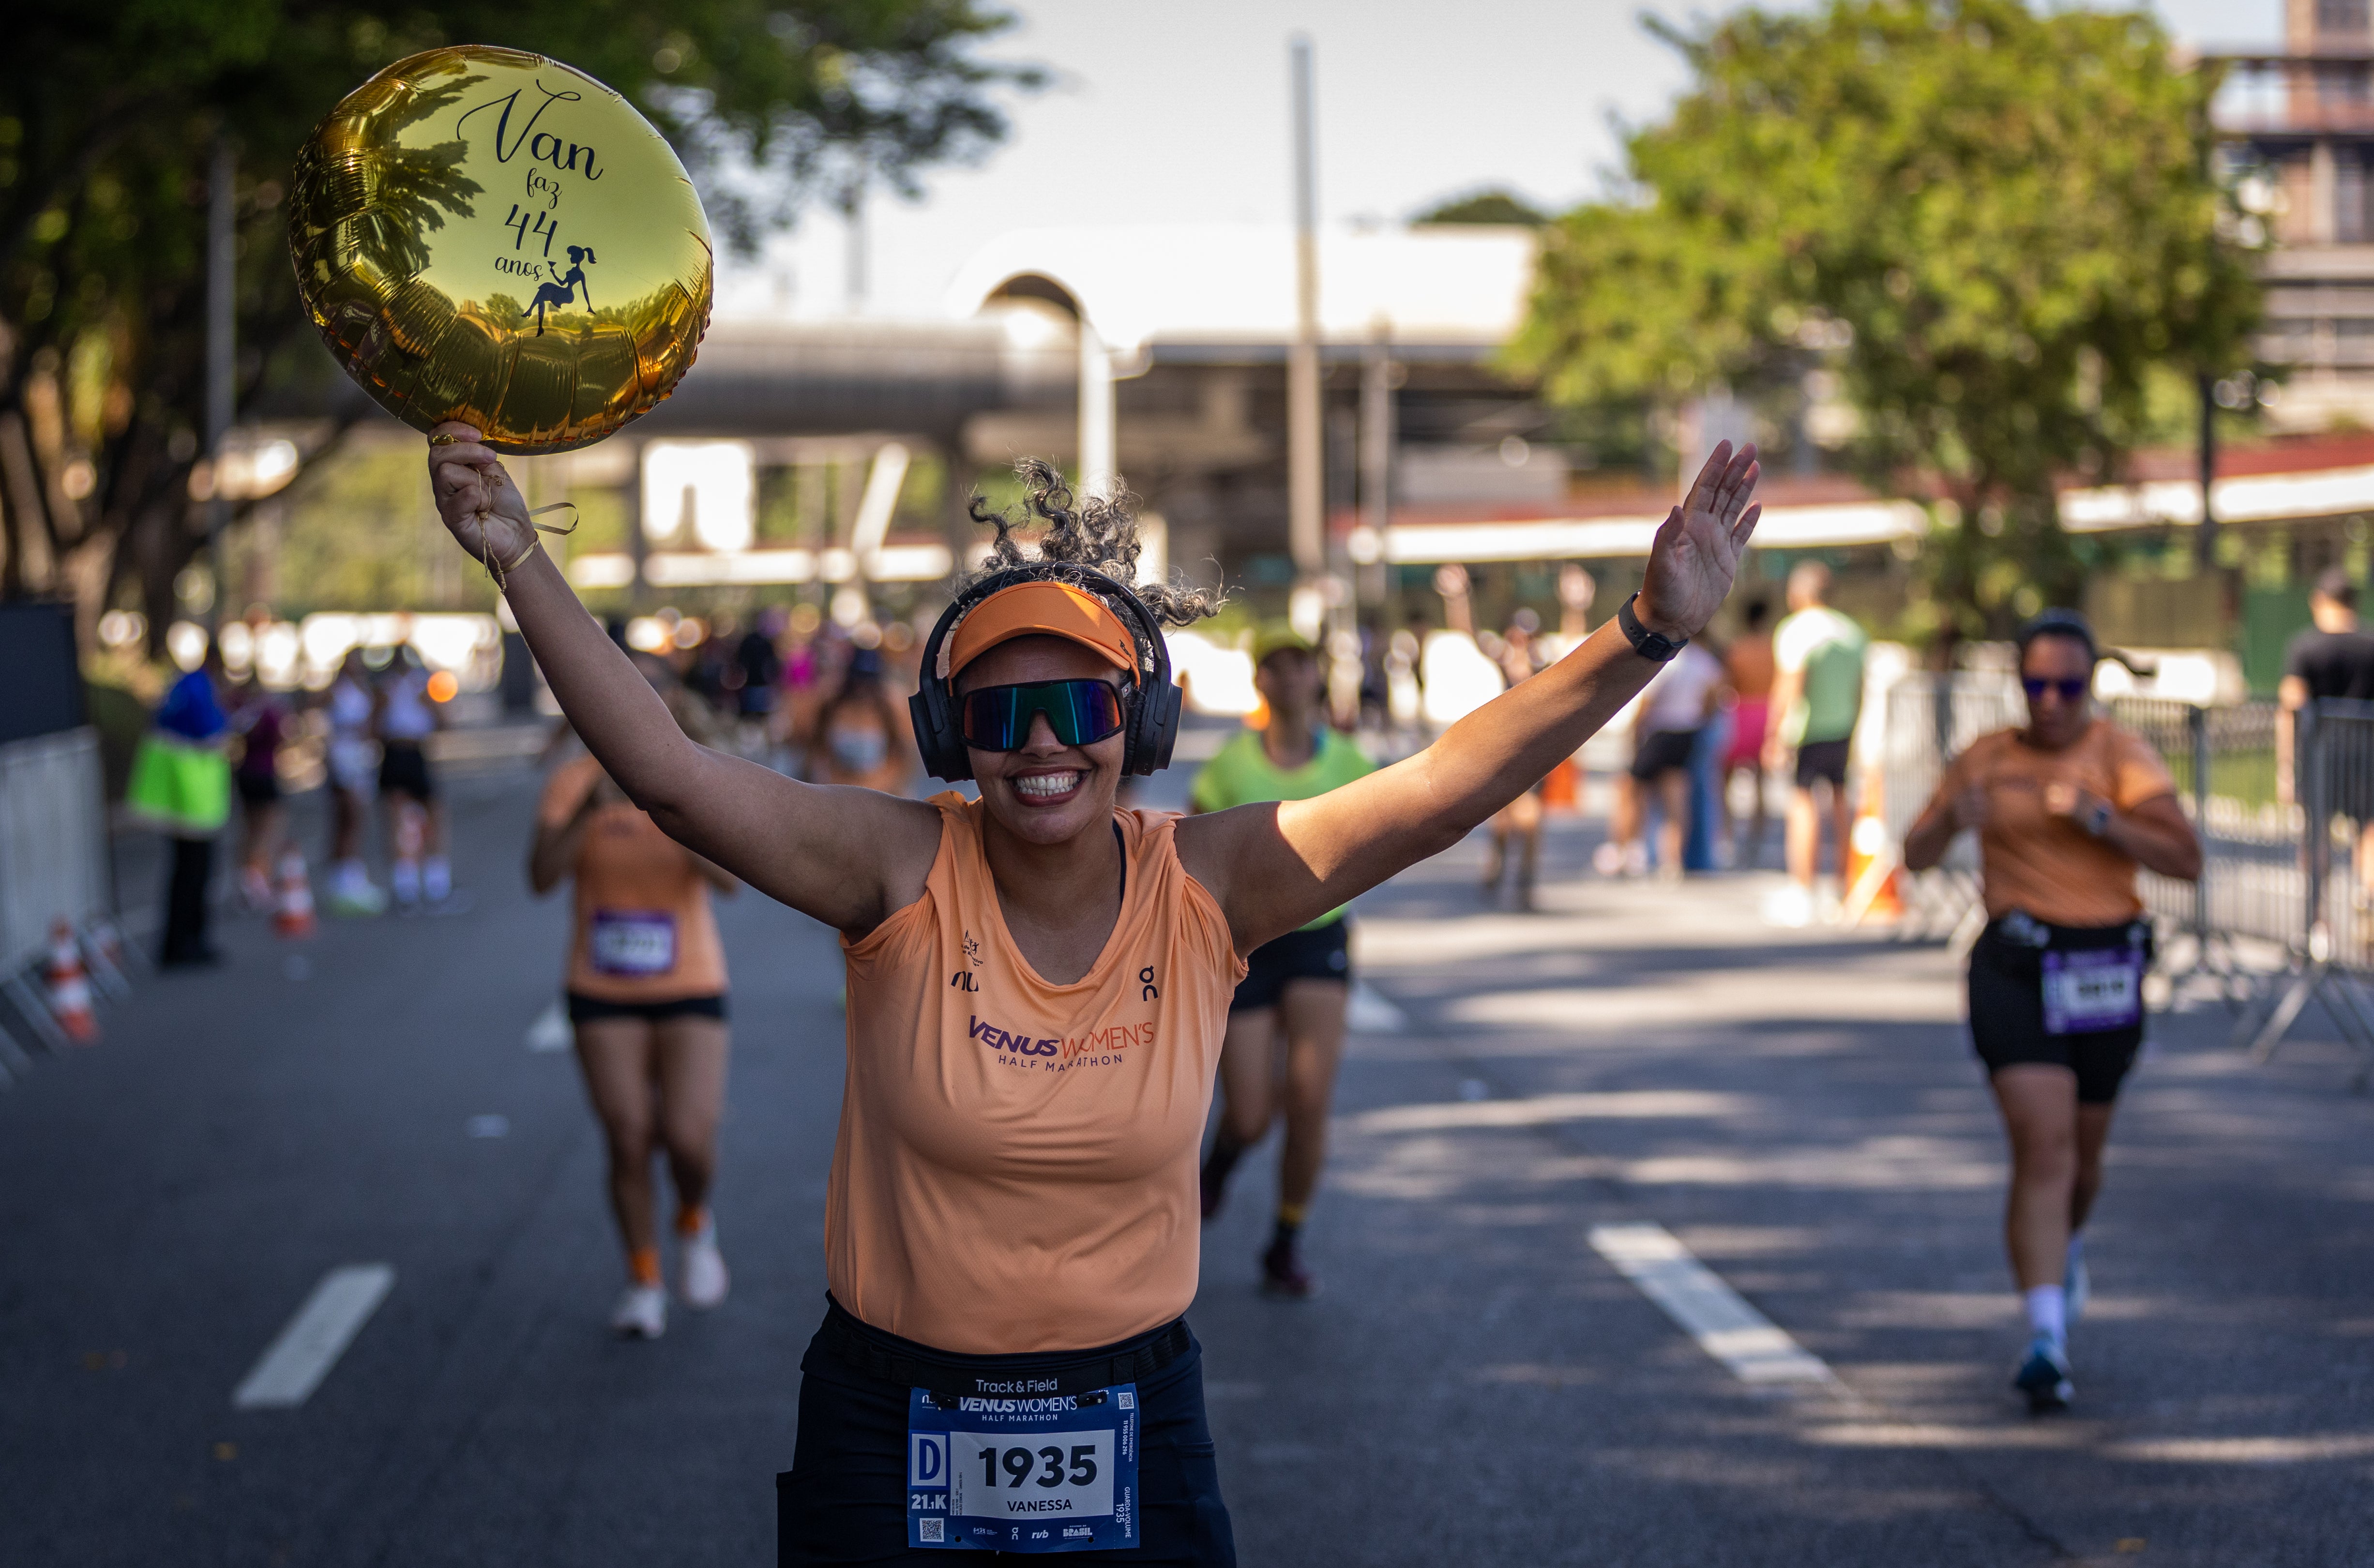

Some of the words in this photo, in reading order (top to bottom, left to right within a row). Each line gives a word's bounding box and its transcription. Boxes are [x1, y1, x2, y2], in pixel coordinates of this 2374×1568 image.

[456, 79, 604, 181] Van
[527, 167, 562, 210] faz
[505, 204, 558, 257] 44
[495, 256, 543, 281] anos
[969, 1015, 1059, 1057] VENUS
[998, 1055, 1038, 1069] HALF
[1045, 1054, 1122, 1072] MARATHON
[922, 1394, 936, 1403] n
[960, 1397, 1015, 1413] VENUS
[1017, 1396, 1077, 1412] WOMEN'S
[919, 1438, 940, 1480] D
[979, 1445, 1097, 1488] 1935
[911, 1494, 947, 1509] 21.1K
[1007, 1499, 1073, 1512] VANESSA
[1116, 1503, 1125, 1523] 1935
[1031, 1529, 1049, 1539] rvb
[1063, 1527, 1093, 1537] BRASIL
